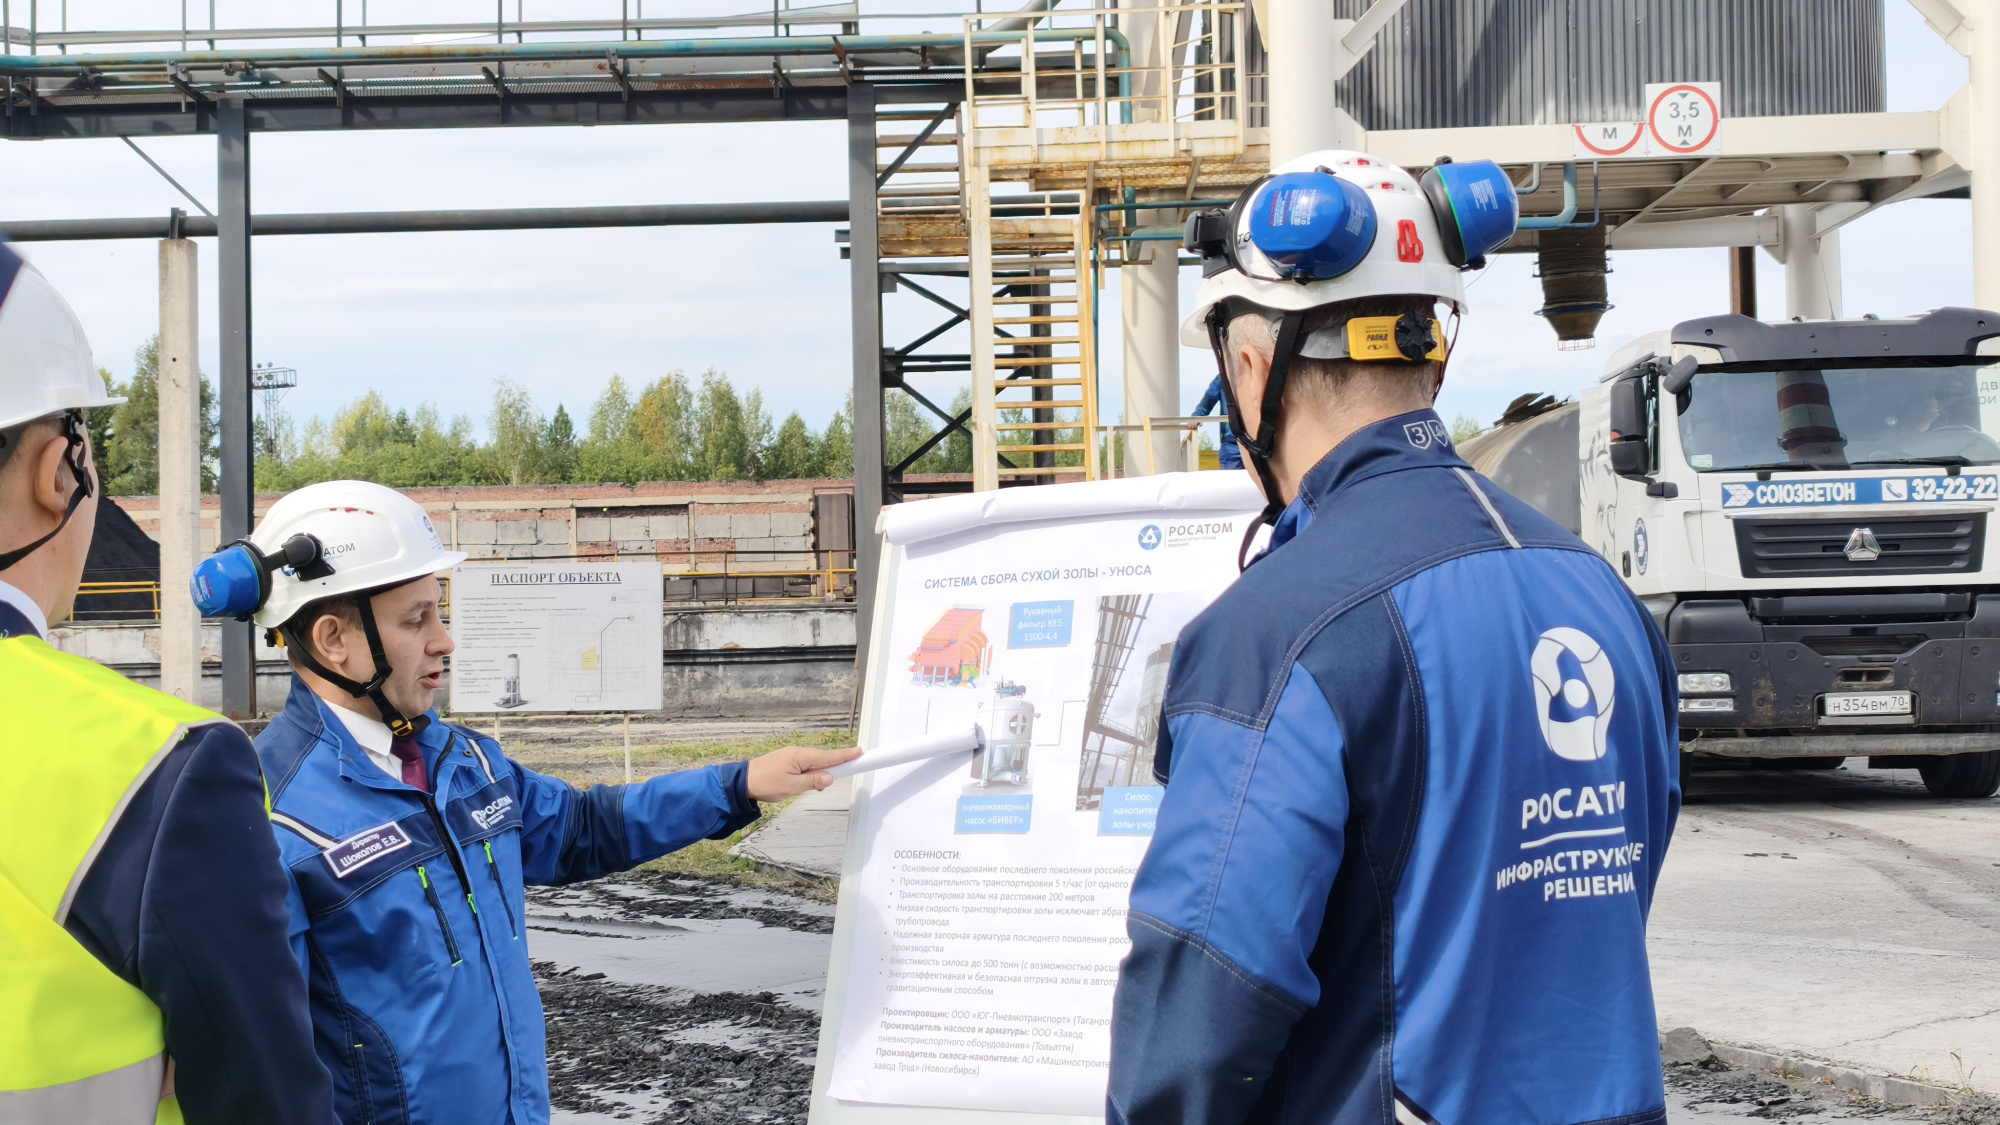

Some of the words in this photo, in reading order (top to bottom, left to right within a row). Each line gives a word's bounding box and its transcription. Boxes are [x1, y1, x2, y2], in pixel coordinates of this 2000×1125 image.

[1669, 102, 1699, 121] 3,5
[1603, 127, 1617, 139] М
[1678, 125, 1692, 137] М
[1980, 382, 1998, 392] ДВ
[1756, 482, 1856, 504] СОЮЗБЕТОН
[1912, 477, 1997, 500] 32-22-22
[1168, 522, 1232, 536] РОСАТОМ
[323, 543, 356, 557] АТОМ
[491, 572, 556, 584] ПАСПОРТ
[558, 572, 622, 583] ОБЪЕКТА
[924, 576, 978, 589] СИСТЕМА
[980, 574, 1018, 586] СБОРА
[1021, 568, 1060, 582] СУХОЙ
[1064, 567, 1098, 580] ЗОЛЫ
[1109, 565, 1152, 577] УНОСА
[1023, 606, 1062, 617] Рукавный
[1018, 619, 1046, 630] фильтр
[1048, 619, 1066, 628] KES-
[1833, 698, 1888, 712] Н354ВМ
[1891, 696, 1904, 706] 70
[1125, 792, 1154, 802] Силос-
[961, 802, 1030, 812] пневмокамерный
[1114, 807, 1158, 816] накопител
[1522, 781, 1625, 830] РОСАТ
[964, 816, 986, 825] насос
[988, 816, 1024, 825] «БИВЕР»
[1112, 820, 1157, 830] золы-унос
[351, 833, 380, 850] Директор
[894, 850, 962, 860] ОСОБЕННОСТИ:
[902, 864, 940, 873] Основное
[942, 865, 997, 875] оборудование
[1000, 866, 1047, 875] последнего
[1094, 866, 1139, 876] российско
[900, 877, 980, 887] Производительность
[983, 879, 1053, 889] транспортировки
[1056, 879, 1060, 888] 5
[1063, 879, 1082, 890] т/час
[1085, 879, 1097, 890] (от
[1099, 880, 1128, 890] одного
[1544, 871, 1635, 902] РЕШЕНИ
[899, 890, 964, 900] Транспортировка
[1000, 893, 1046, 902] расстояние
[1048, 893, 1064, 901] 200
[1065, 894, 1095, 903] метров
[896, 904, 924, 912] Низкая
[925, 905, 960, 914] скорость
[962, 906, 1032, 916] транспортировки
[1056, 908, 1100, 916] исключает
[1102, 907, 1128, 917] абраз
[895, 916, 950, 927] трубопровода
[893, 930, 932, 939] Надежная
[934, 931, 970, 941] запорная
[972, 932, 1011, 943] арматура
[1013, 934, 1060, 943] последнего
[1062, 936, 1107, 944] поколения
[1109, 936, 1132, 946] росси
[891, 944, 944, 954] производства
[890, 957, 940, 966] Вместимость
[942, 958, 968, 967] силоса
[970, 960, 982, 969] до
[984, 959, 998, 968] 500
[1022, 960, 1028, 971] (с
[1030, 962, 1092, 971] возможностью
[1094, 964, 1120, 973] расши
[888, 970, 966, 980] Энергоэффективная
[975, 972, 1022, 983] безопасная
[1024, 976, 1058, 985] отгрузка
[1090, 978, 1119, 988] автотр
[886, 984, 952, 994] гравитационным
[954, 986, 994, 996] способом
[882, 1007, 950, 1018] Проектировщик:
[952, 1010, 970, 1019] ООО
[972, 1011, 1071, 1025] «ЮГ-Пневмотранспорт»
[1073, 1015, 1110, 1027] (Таганро
[880, 1020, 942, 1032] Производитель
[944, 1026, 976, 1034] насосов
[985, 1026, 1030, 1036] арматуры:
[1032, 1028, 1052, 1037] ООО
[1054, 1029, 1083, 1040] «Завод
[878, 1035, 964, 1046] пневмотранспортного
[966, 1038, 1030, 1049] оборудования»
[1032, 1042, 1074, 1054] (Тольятти)
[876, 1048, 937, 1059] Производитель
[939, 1051, 1020, 1063] силоса-накопителя:
[1022, 1055, 1034, 1064] АО
[1036, 1056, 1111, 1069] «Машиностроите
[873, 1062, 896, 1071] завод
[898, 1062, 920, 1073] Труд»
[922, 1063, 980, 1076] (Новосибирск)
